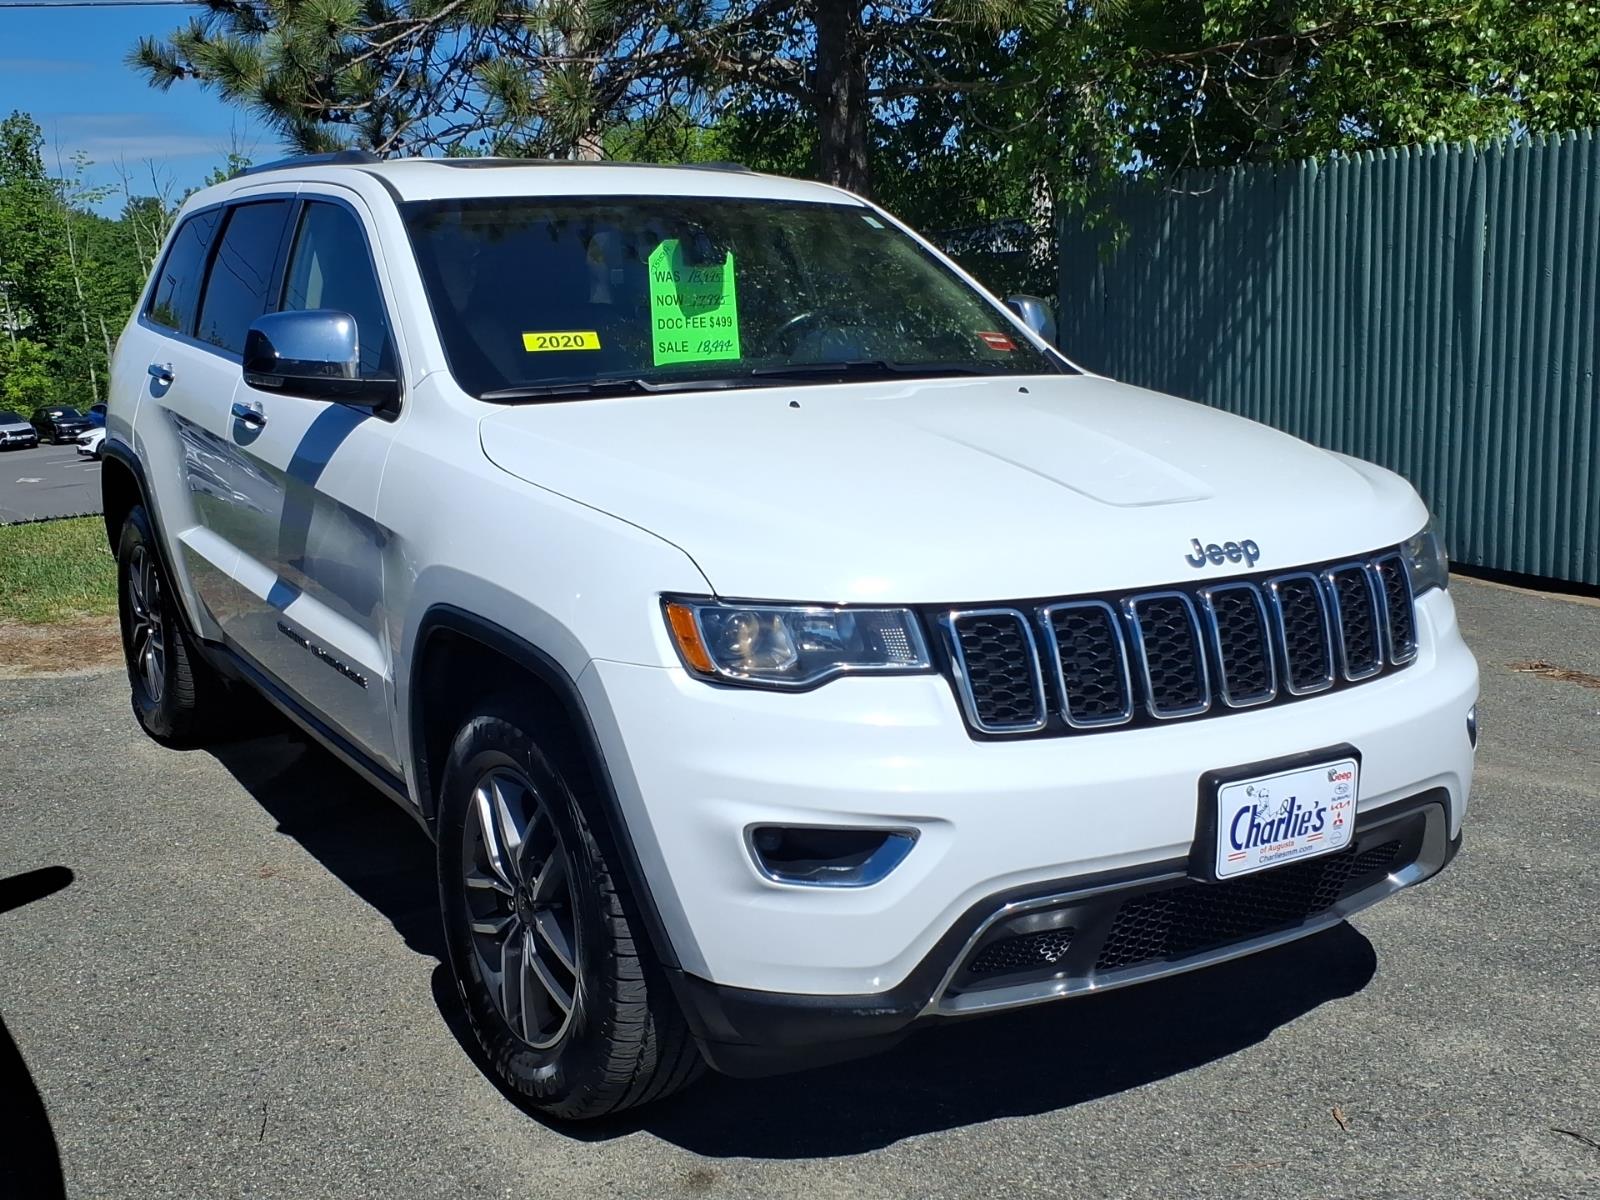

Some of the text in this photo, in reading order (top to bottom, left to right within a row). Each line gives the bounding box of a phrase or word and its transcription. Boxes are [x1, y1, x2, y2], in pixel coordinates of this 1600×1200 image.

[655, 270, 680, 283] WAS
[656, 294, 684, 307] NOW
[657, 316, 732, 330] DOC FEE $499
[536, 335, 584, 349] 2020
[658, 341, 688, 353] SALE
[1184, 538, 1260, 568] Jeep
[1230, 796, 1327, 851] Charlie's
[1259, 845, 1313, 863] Charliesmm.com
[1260, 840, 1295, 854] of Augusta
